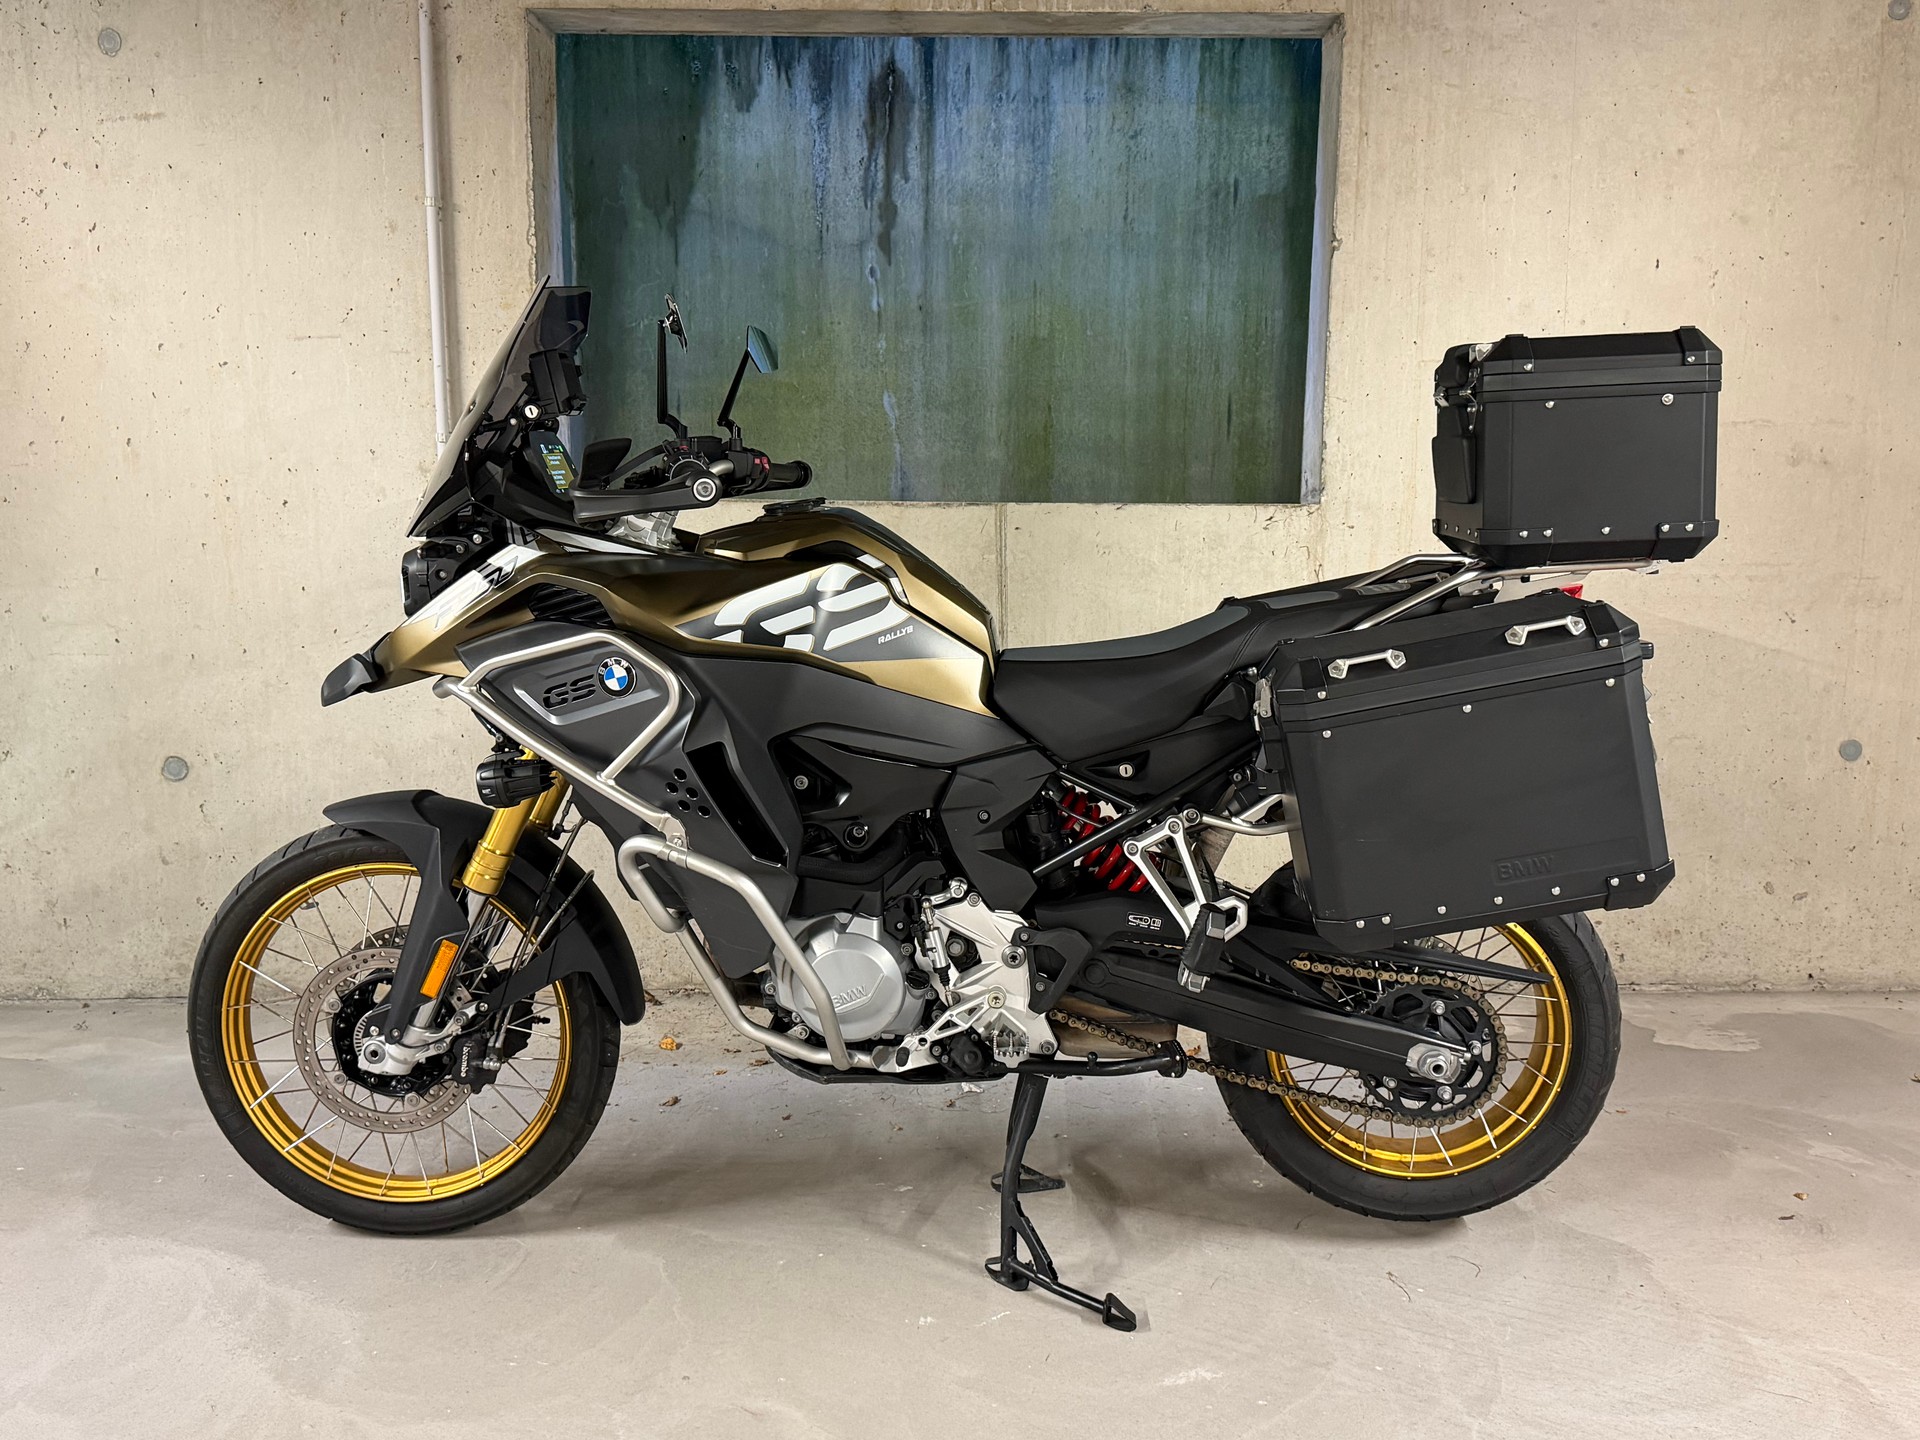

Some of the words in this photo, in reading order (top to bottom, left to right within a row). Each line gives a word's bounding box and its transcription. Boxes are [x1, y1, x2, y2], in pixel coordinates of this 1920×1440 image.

[543, 674, 597, 709] GS
[1498, 856, 1554, 880] BMW
[832, 984, 868, 1008] BMW
[460, 1046, 471, 1078] brembo
